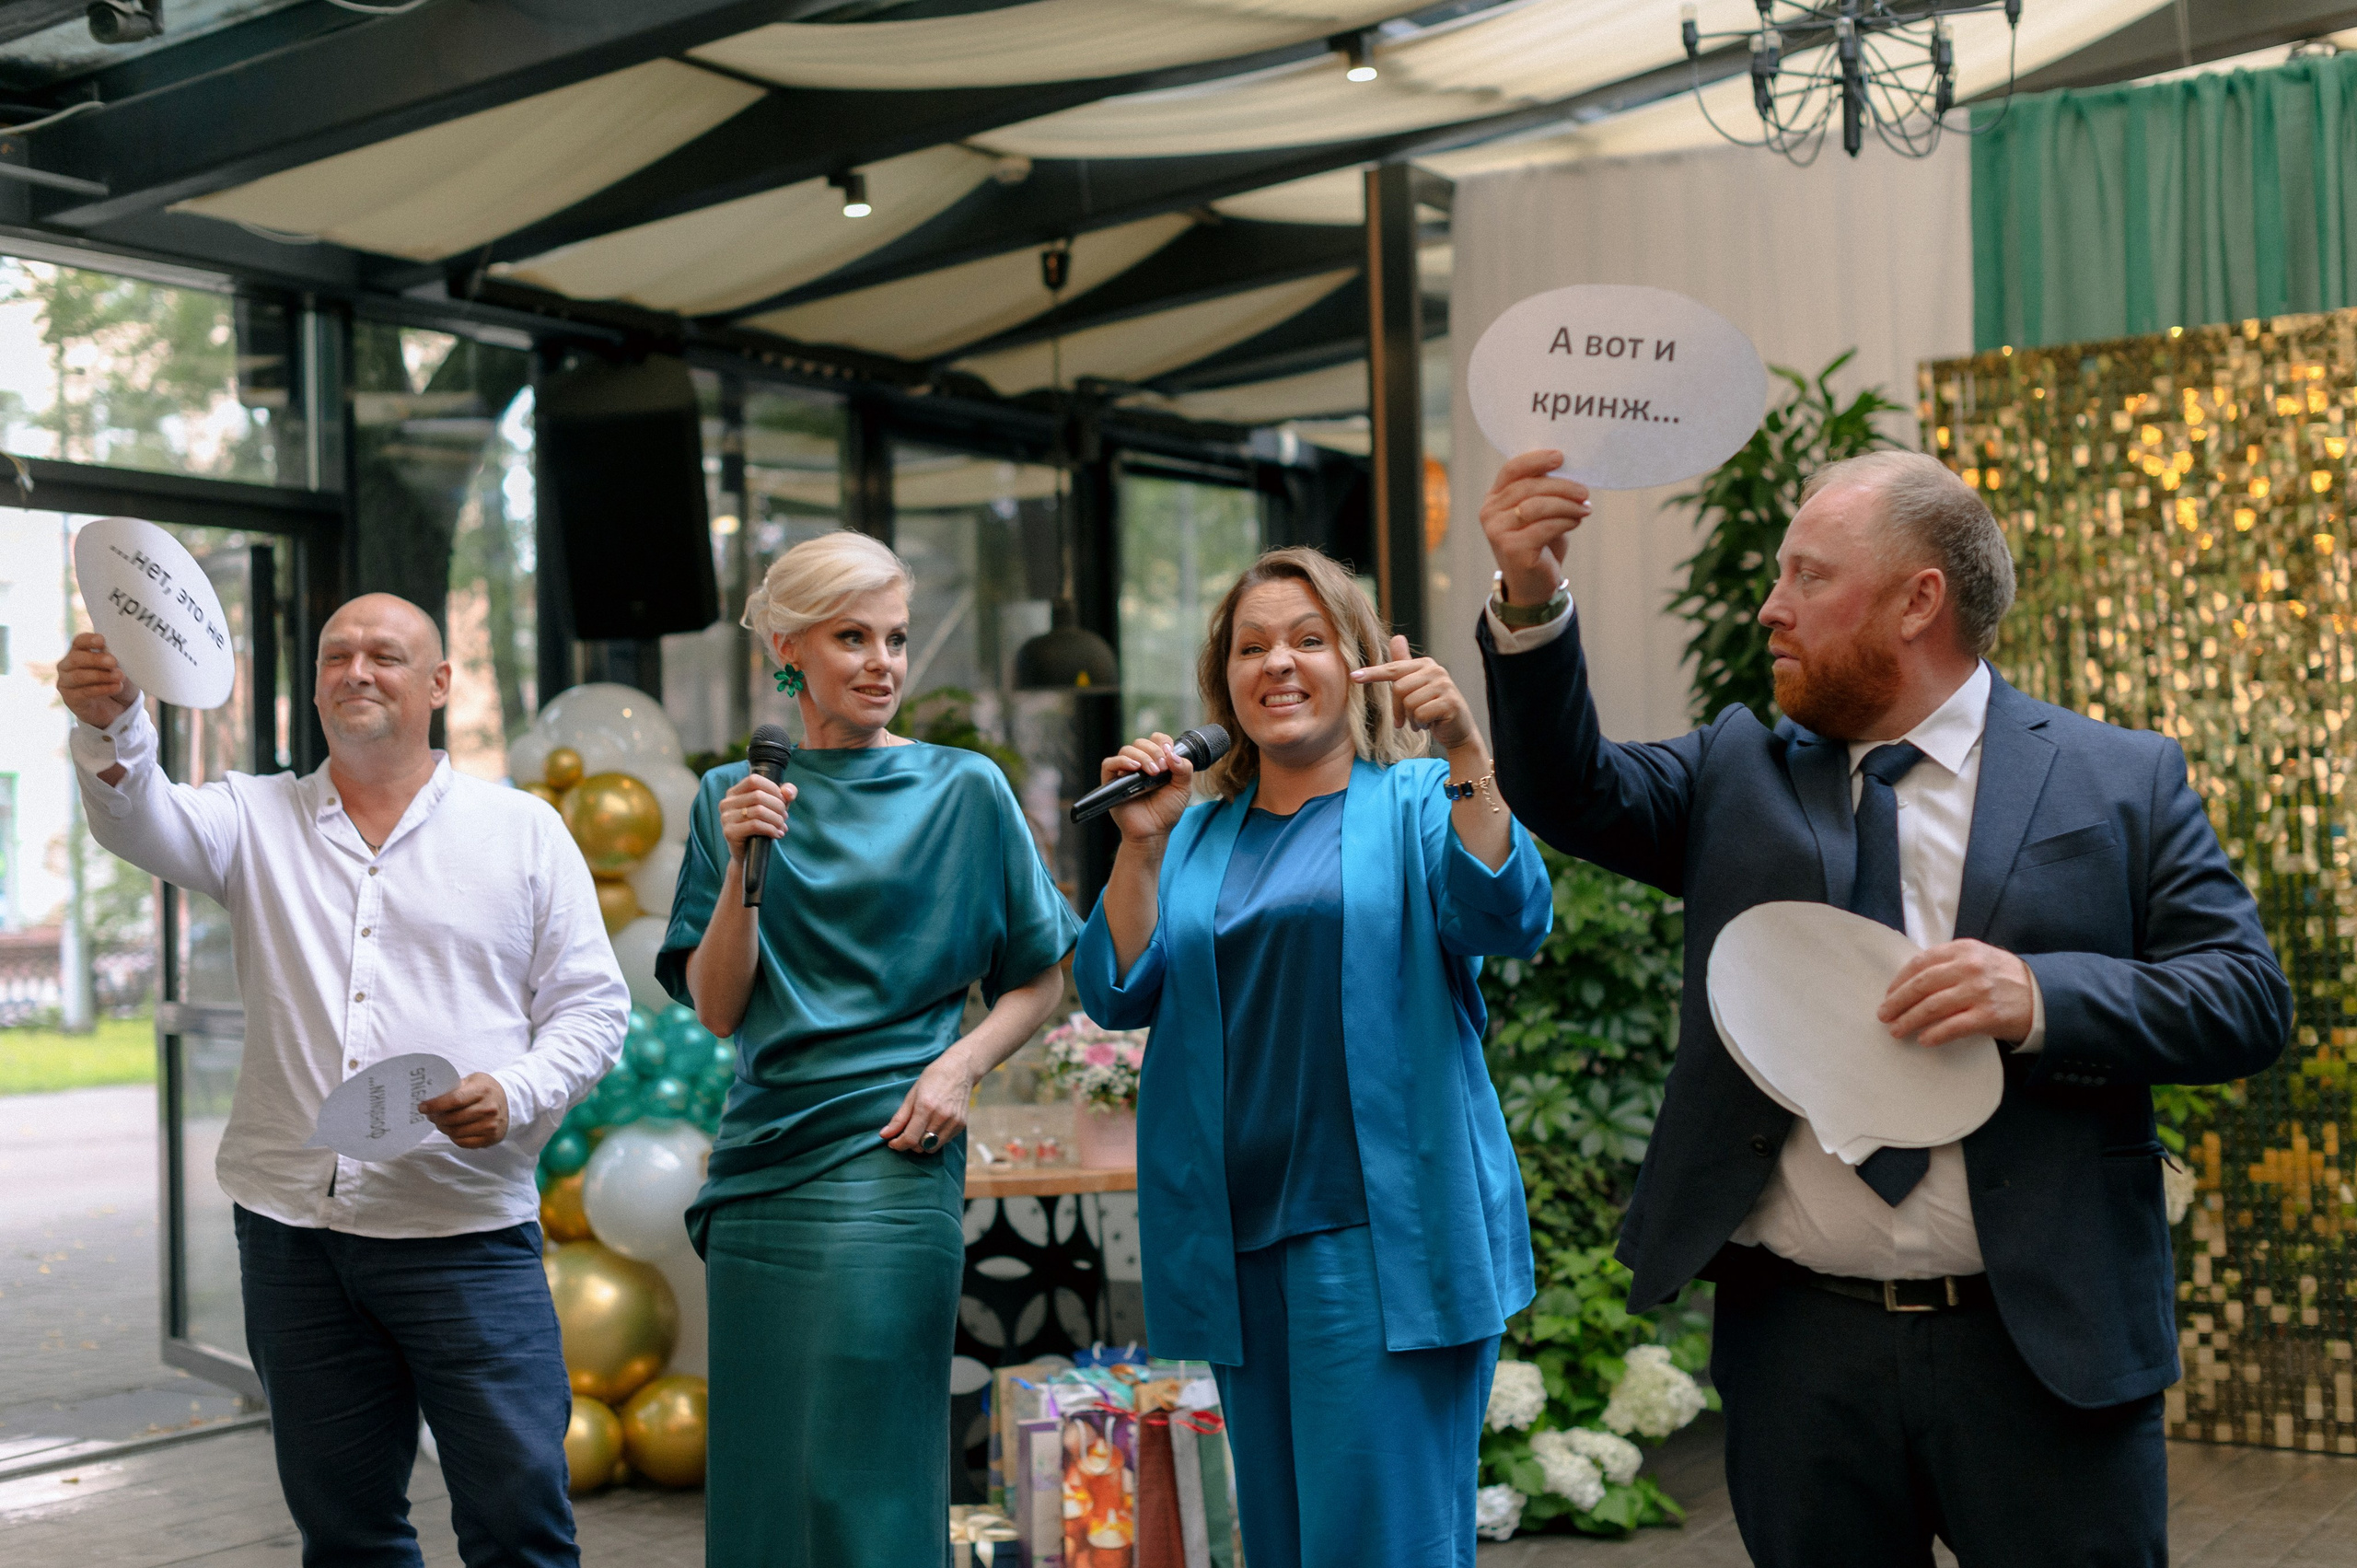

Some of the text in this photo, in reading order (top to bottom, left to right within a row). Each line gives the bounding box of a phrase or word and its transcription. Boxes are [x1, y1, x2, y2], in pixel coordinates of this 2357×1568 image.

[1548, 326, 1678, 363] А вот и
[1531, 390, 1680, 424] кринж...
[109, 544, 226, 651] ...нет, это не
[106, 587, 199, 667] кринж...
